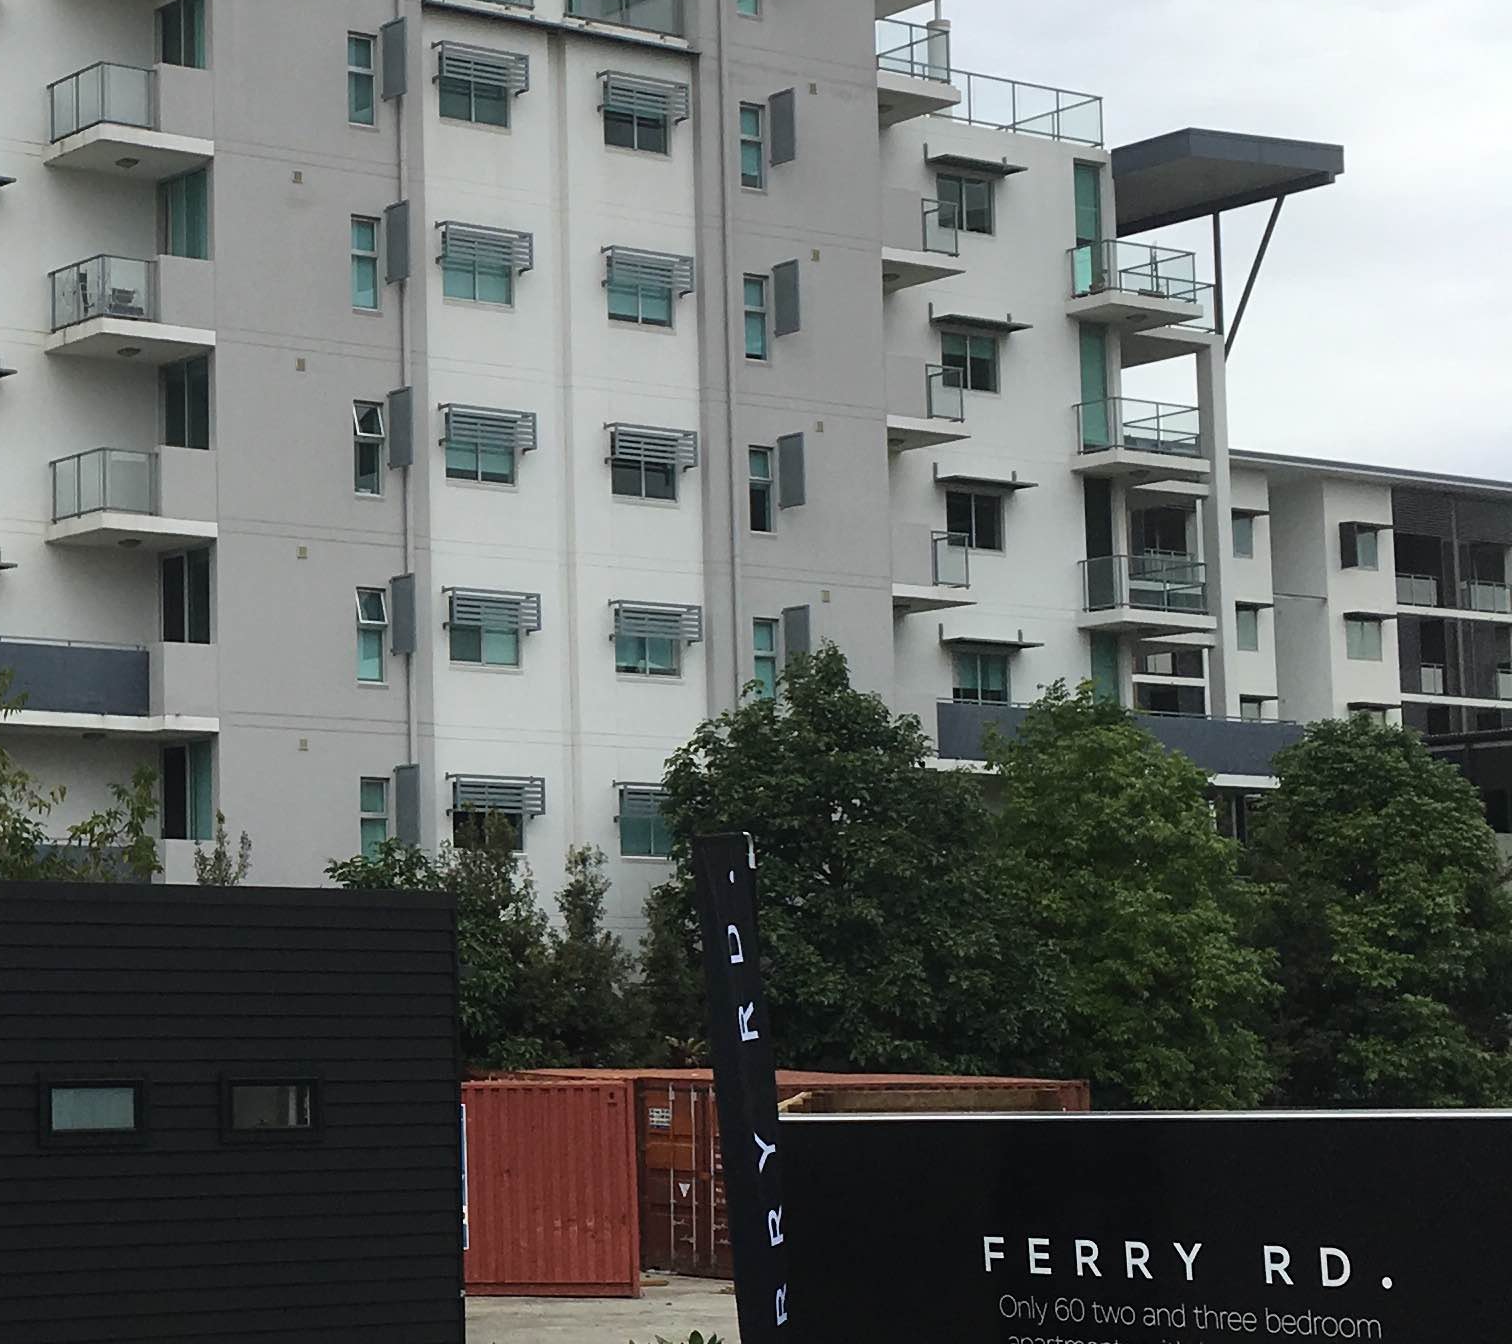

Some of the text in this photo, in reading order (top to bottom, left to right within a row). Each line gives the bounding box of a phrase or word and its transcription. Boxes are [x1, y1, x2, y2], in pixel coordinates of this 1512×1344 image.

[983, 1235, 1393, 1290] FERRY RD.
[999, 1294, 1382, 1339] Only 60 two and three bedroom
